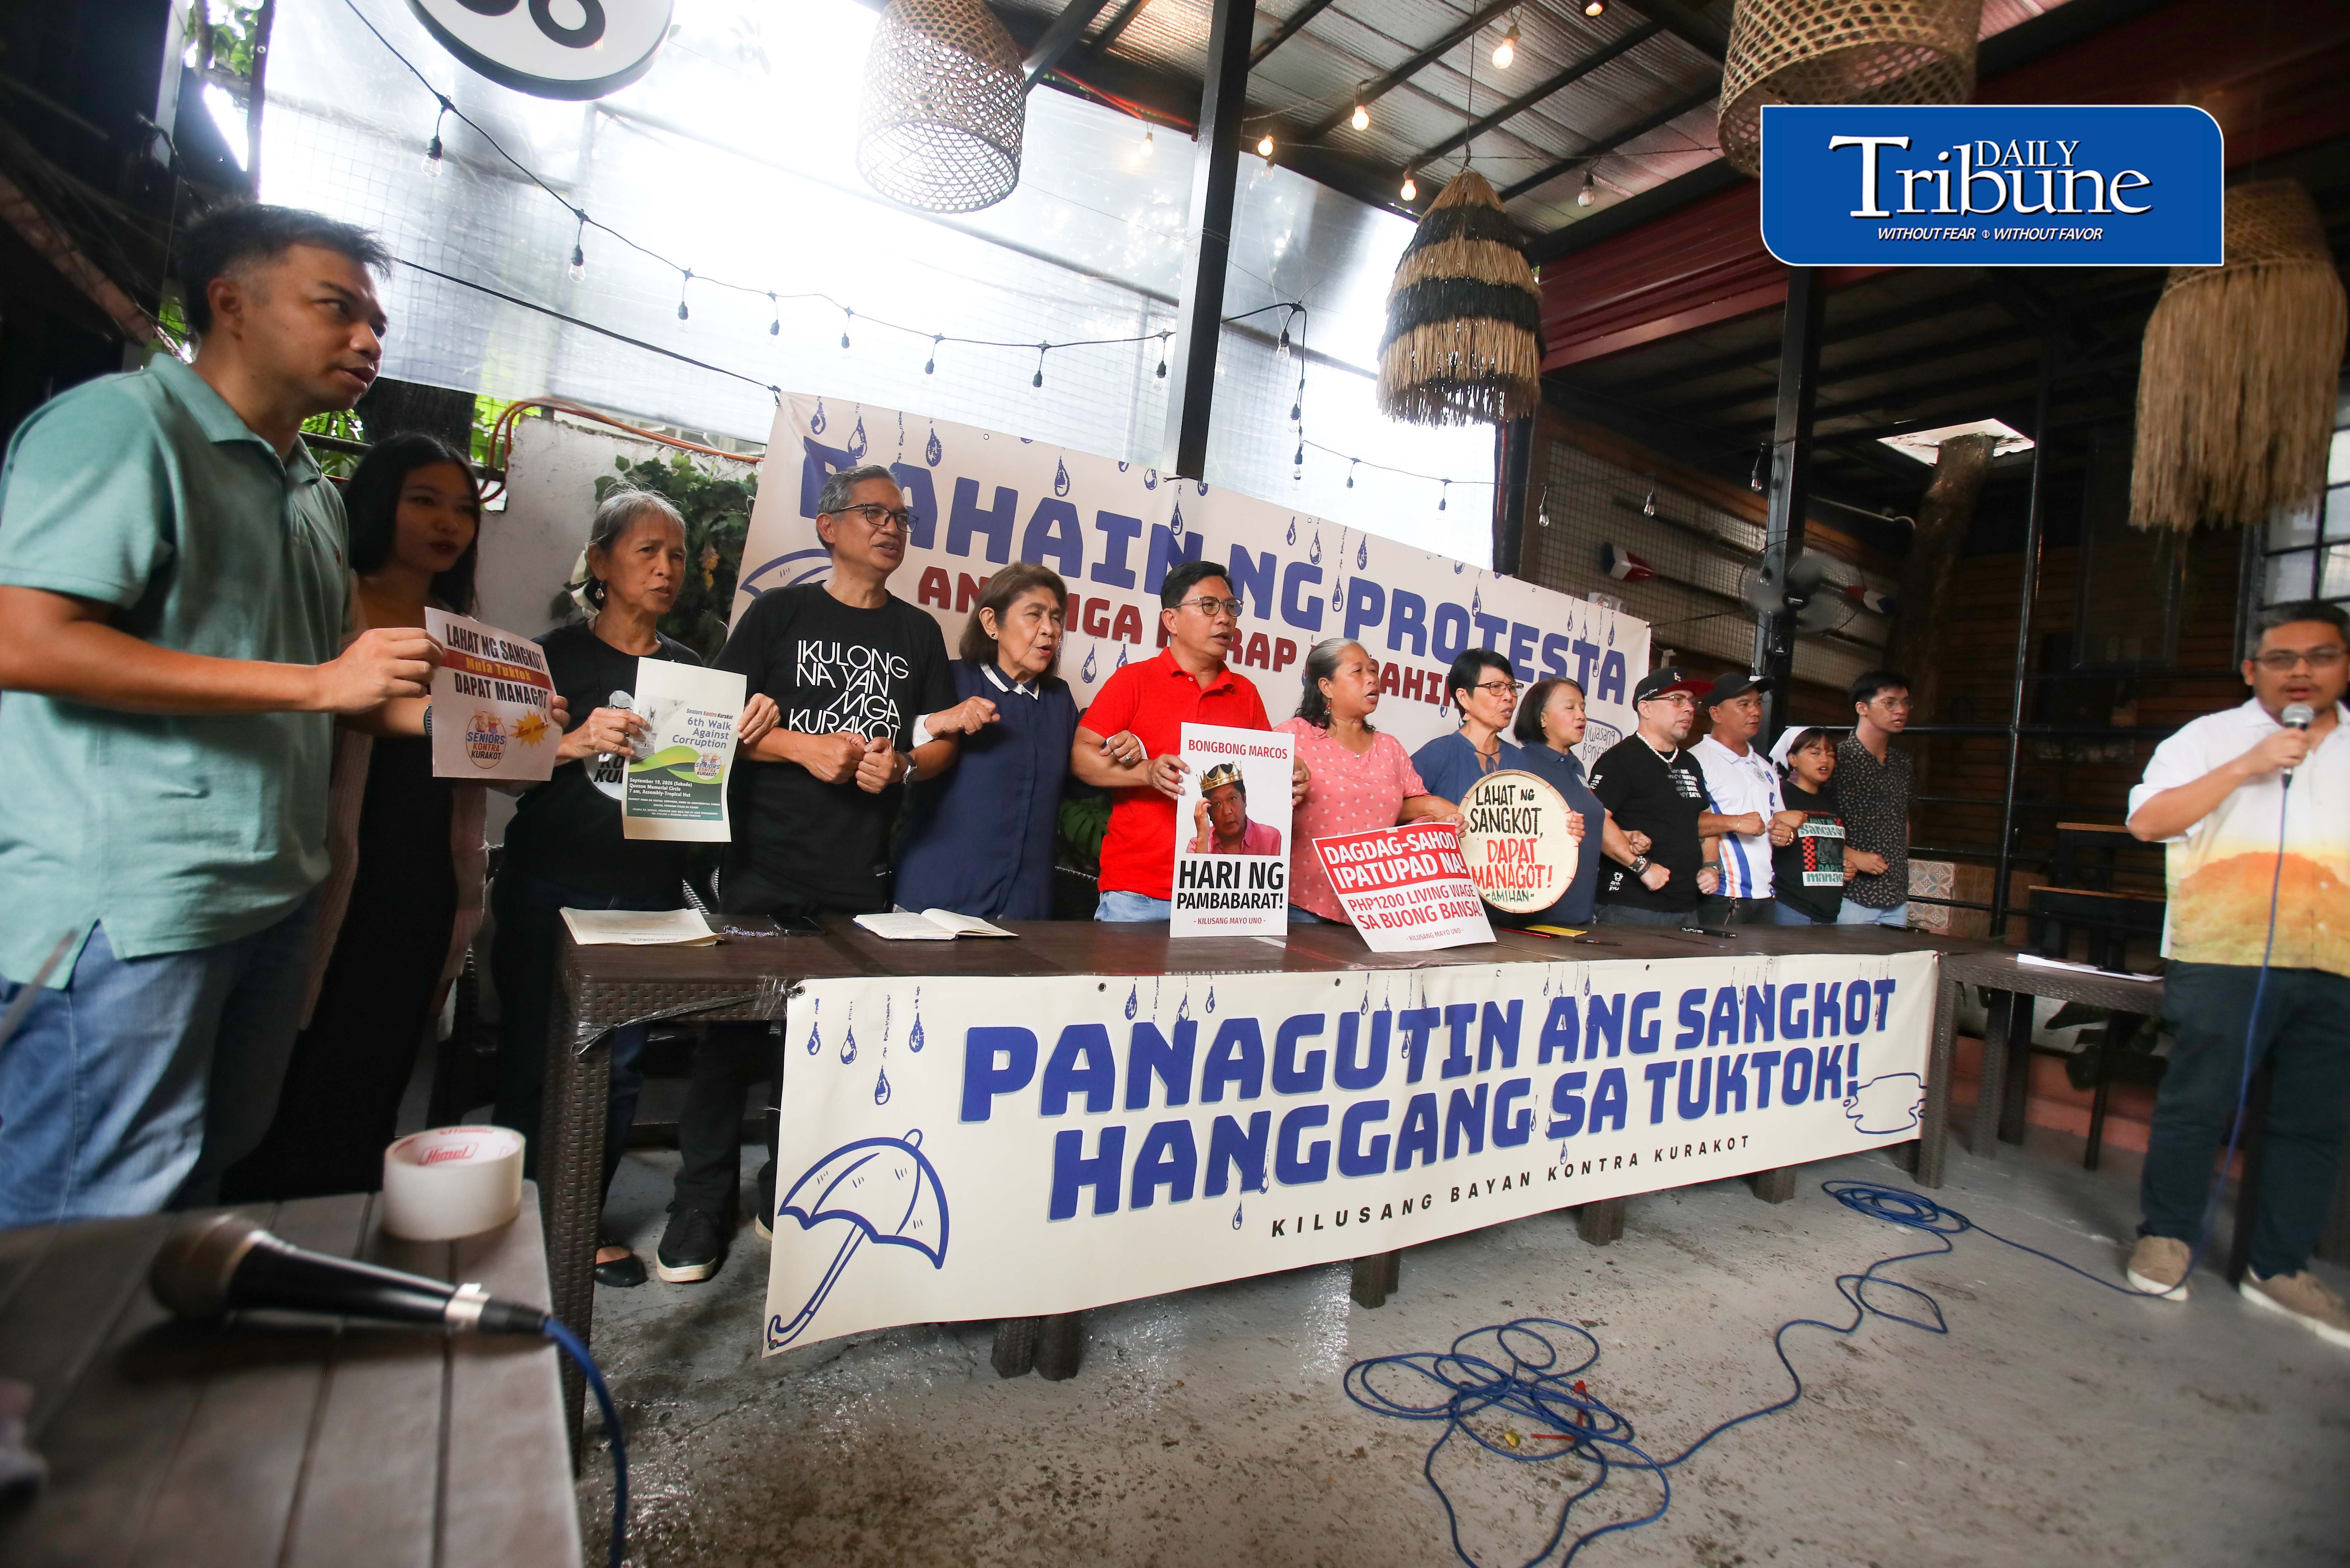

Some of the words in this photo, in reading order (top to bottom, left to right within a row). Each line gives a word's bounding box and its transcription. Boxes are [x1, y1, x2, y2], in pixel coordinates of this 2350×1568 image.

[917, 566, 992, 613] AN
[1066, 593, 1143, 644] GA
[1229, 544, 1324, 632] NG
[1344, 576, 1626, 705] PROTESTA
[446, 623, 479, 654] LAHAT
[481, 635, 499, 659] NG
[499, 640, 545, 671] SANGKOT
[797, 640, 909, 679] IKULONG
[466, 658, 492, 674] Mula
[496, 664, 532, 681] Tuktok
[796, 662, 836, 688] NA
[841, 665, 889, 697] YAN
[454, 672, 491, 699] DAPAT
[495, 681, 548, 709] MANAGOT
[826, 691, 901, 726] MGA
[467, 732, 505, 745] SENIORS
[688, 717, 704, 727] 6th
[709, 720, 731, 731] Walk
[693, 727, 729, 740] Against
[789, 708, 901, 747] KURAKOT
[471, 750, 502, 760] KURAKOT
[473, 742, 500, 752] KONTRA
[673, 735, 727, 749] Corruption
[1188, 739, 1246, 755] BONGBONG
[1249, 746, 1287, 759] MARCOS
[1476, 785, 1516, 805] LAHAT
[1521, 789, 1535, 801] NG
[1470, 807, 1543, 838] SANGKOT,
[1324, 831, 1457, 865] DAGDAG-SAHOD
[1487, 838, 1537, 864] DAPAT
[1179, 860, 1241, 889] HARI
[1249, 862, 1284, 889] NG
[1332, 854, 1439, 889] IPATUPAD
[1441, 851, 1467, 874] NA!
[1471, 864, 1553, 890] MANAGOT!
[1177, 893, 1283, 909] PAMBABARAT!
[1348, 893, 1405, 912] PHP1200
[1408, 885, 1448, 904] LIVING
[1450, 884, 1476, 897] WAGE
[1356, 914, 1381, 930] SA
[1379, 905, 1438, 928] BUONG
[1440, 900, 1483, 920] BANSA!
[959, 999, 1524, 1124] PANAGUTIN
[1538, 991, 1662, 1065] ANG
[1676, 978, 1896, 1052] SANGKOT
[1048, 1077, 1531, 1223] HANGGANG
[1546, 1067, 1627, 1141] SA
[1645, 1042, 1860, 1125] TUKTOK!
[1271, 1194, 1432, 1238] KILUSANG
[1451, 1171, 1531, 1203] BAYAN
[1548, 1152, 1639, 1181] KONTRA
[1654, 1135, 1751, 1162] KURAKOT
